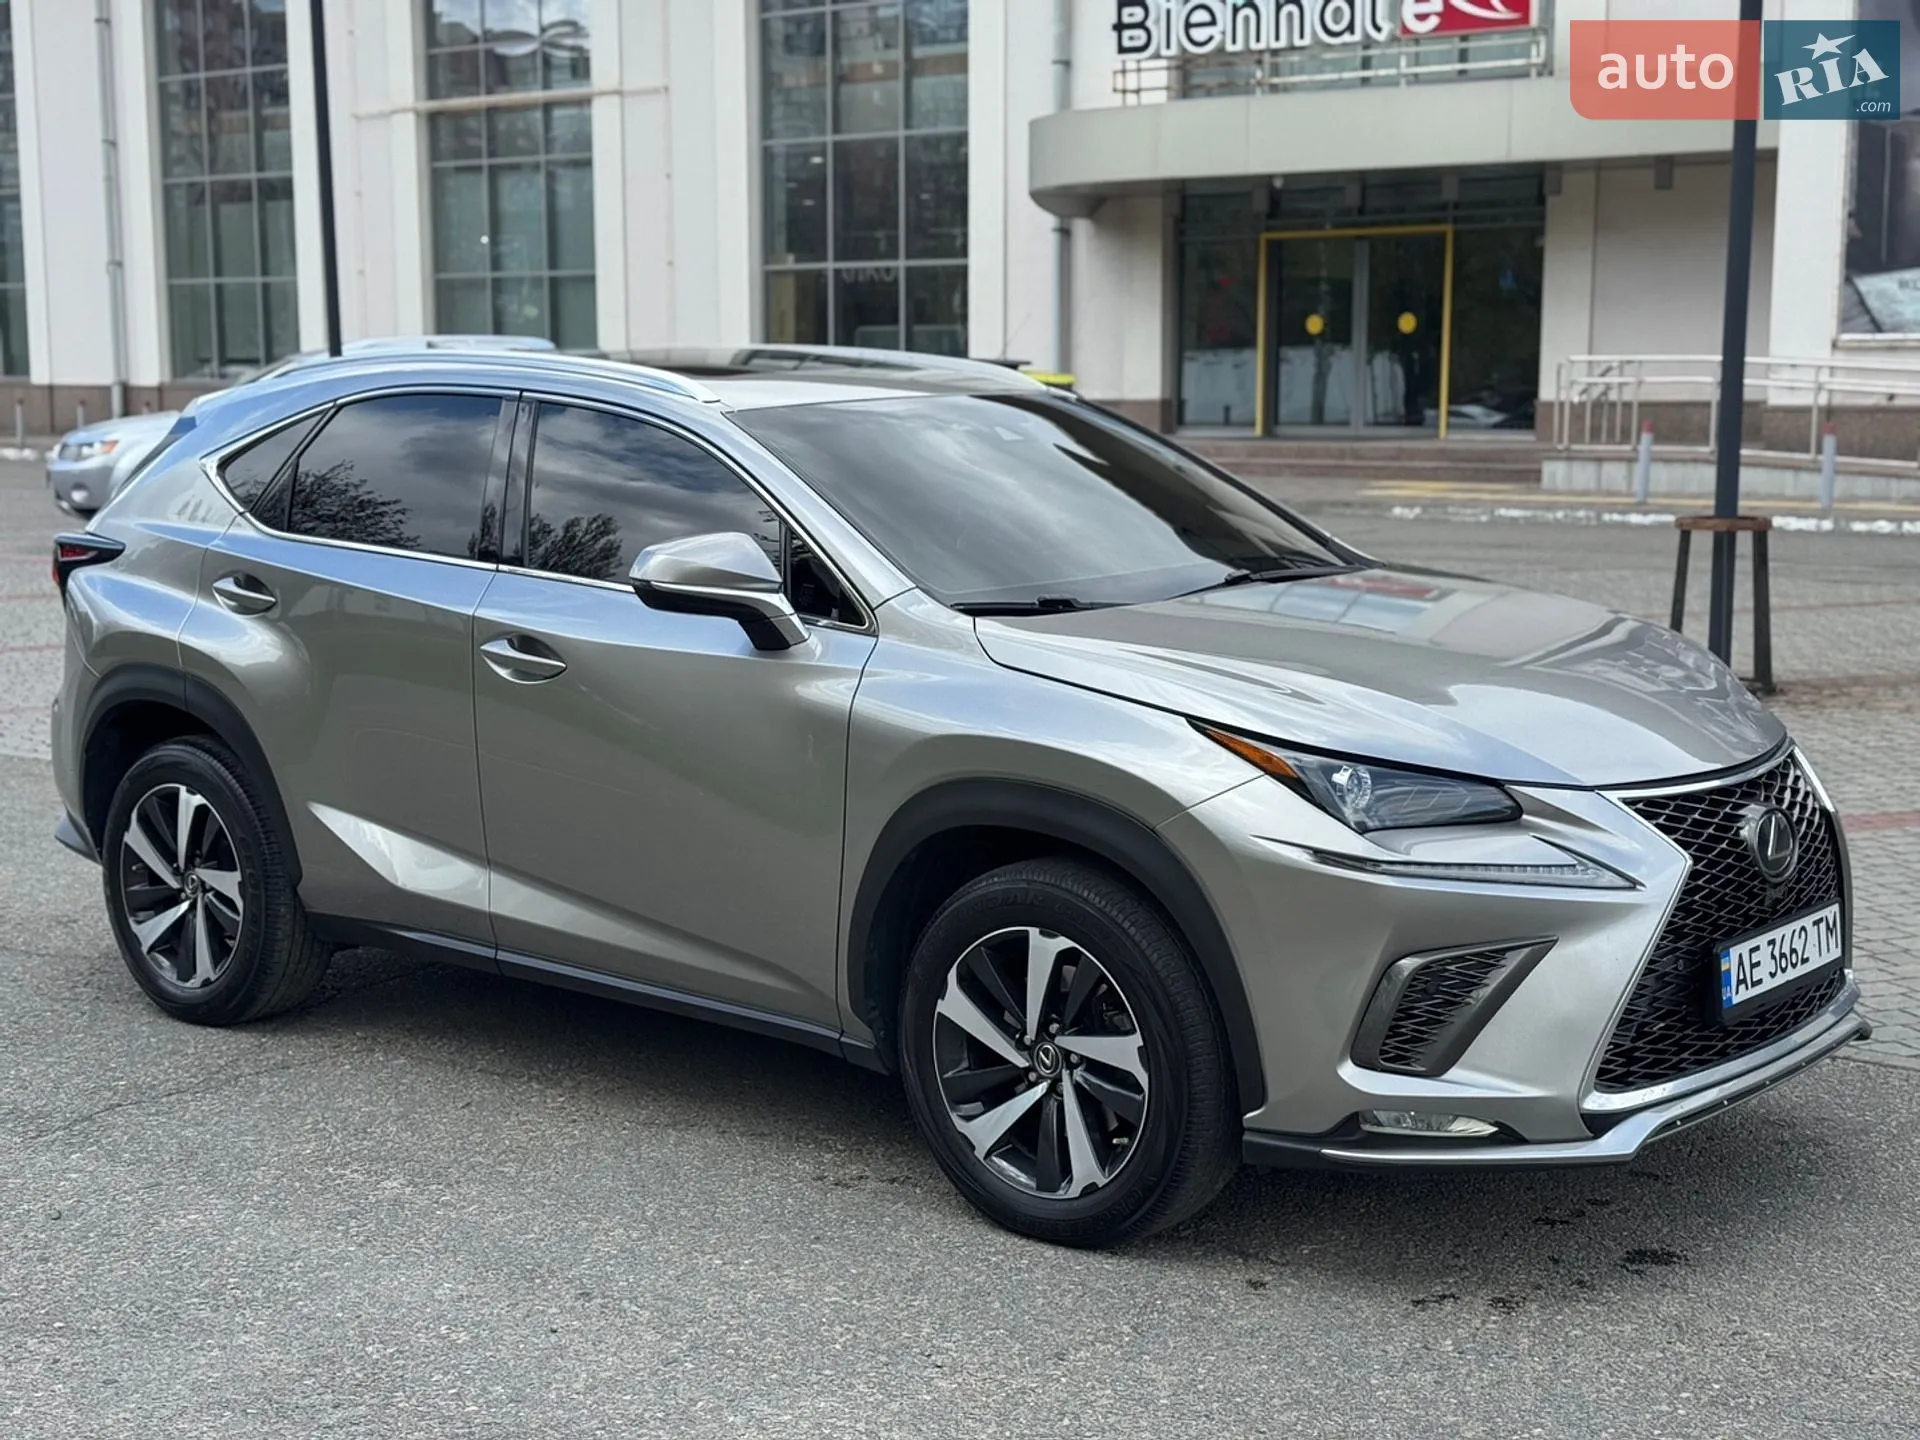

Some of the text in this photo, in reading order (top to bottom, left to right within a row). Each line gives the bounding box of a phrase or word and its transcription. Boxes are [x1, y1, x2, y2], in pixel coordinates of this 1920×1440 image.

[1735, 910, 1839, 996] AE 3662 TM
